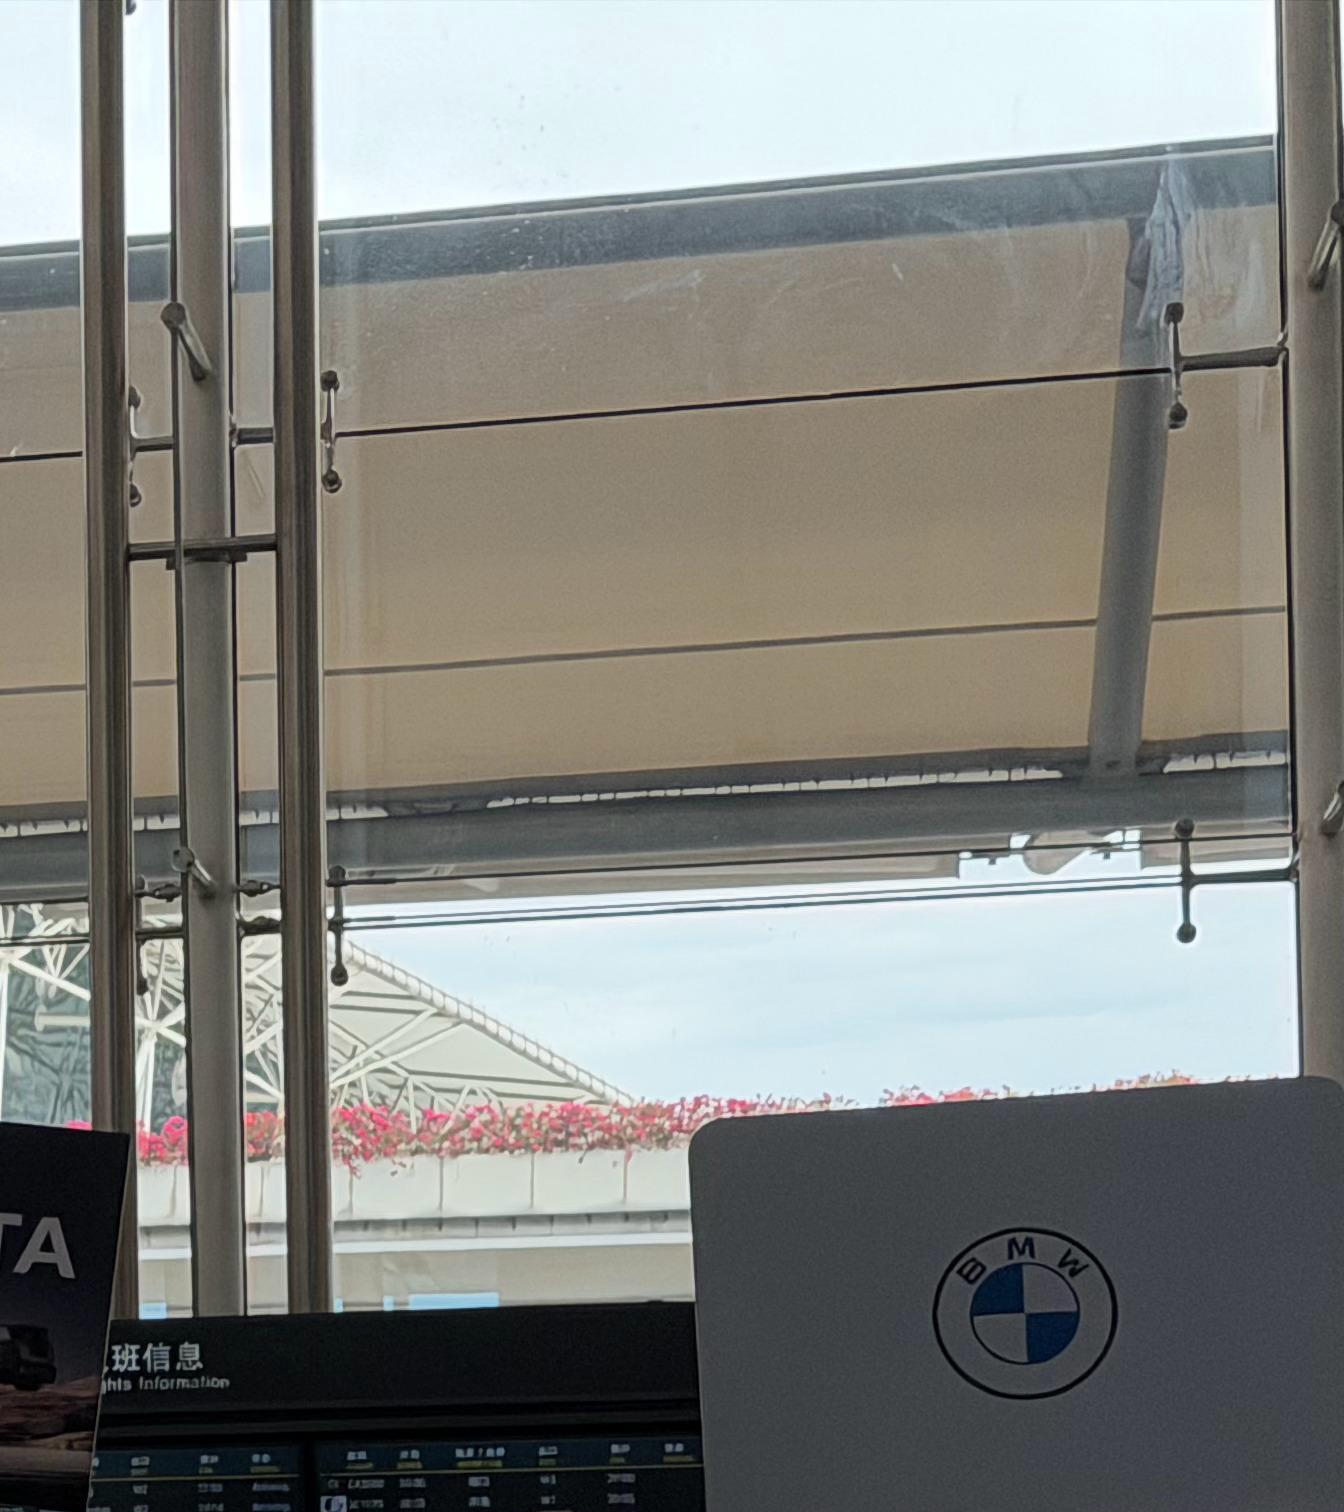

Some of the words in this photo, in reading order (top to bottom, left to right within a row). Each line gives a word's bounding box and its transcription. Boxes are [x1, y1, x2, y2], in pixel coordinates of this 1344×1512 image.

[957, 1237, 1089, 1285] BMW
[103, 1341, 204, 1373] 班信息
[139, 1375, 230, 1391] Information
